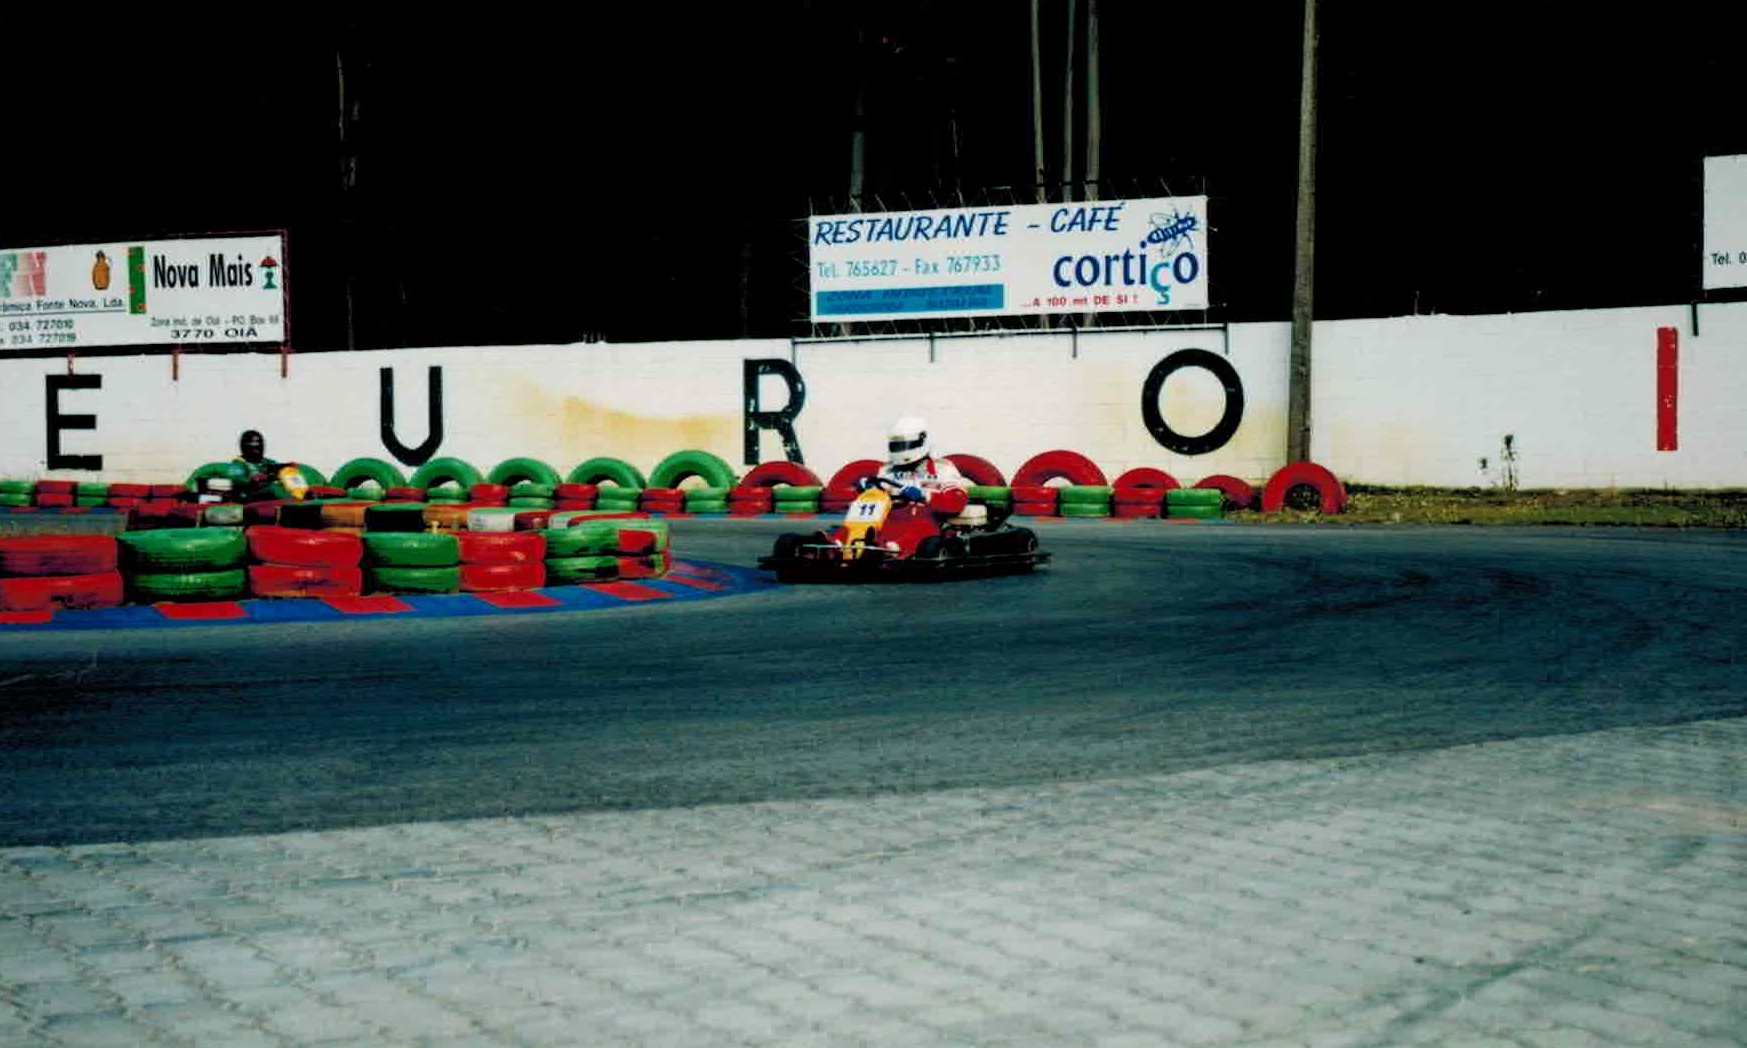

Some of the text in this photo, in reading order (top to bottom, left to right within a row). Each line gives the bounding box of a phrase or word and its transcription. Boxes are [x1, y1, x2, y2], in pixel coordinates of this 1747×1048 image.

[815, 211, 1011, 245] RESTAURANTE
[1050, 202, 1125, 233] CAFÉ
[844, 259, 899, 277] 765627
[914, 258, 939, 275] Fax
[946, 254, 1002, 273] 767933
[1711, 251, 1732, 265] Tel.
[153, 252, 253, 289] Nova Mais
[1053, 240, 1199, 304] cortiço
[1094, 295, 1109, 306] DE
[171, 328, 215, 339] 3770
[859, 503, 876, 516] 11
